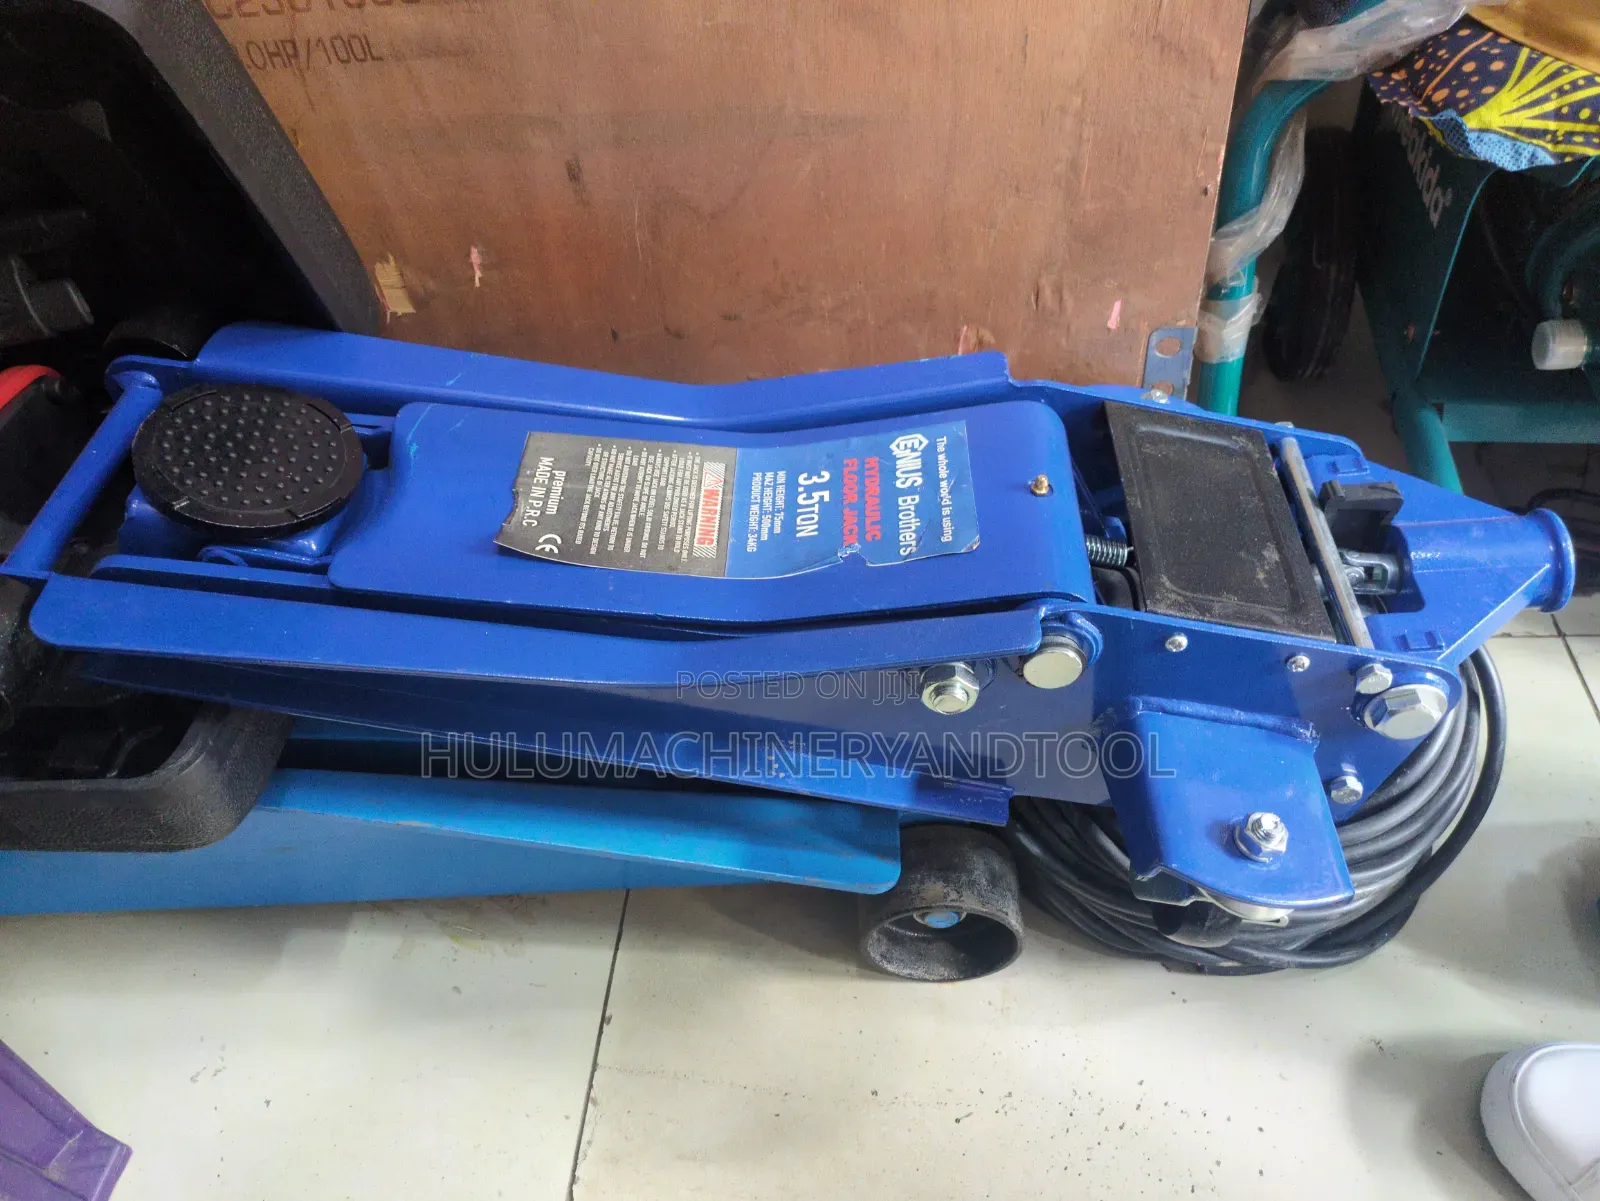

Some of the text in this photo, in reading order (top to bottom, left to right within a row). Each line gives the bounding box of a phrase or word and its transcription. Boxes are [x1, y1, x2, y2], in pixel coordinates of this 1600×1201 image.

[533, 457, 554, 484] MADE
[612, 470, 621, 483] AGENT
[530, 486, 547, 498] IN
[545, 470, 567, 514] premium
[584, 493, 592, 504] JACK
[762, 487, 773, 514] HEIGHT:
[864, 456, 881, 542] HYDRAULIC
[935, 436, 954, 542] The whole world is using
[746, 472, 762, 552] PRODUCT WEIGHT: 34KG
[773, 470, 786, 534] MIN HEIGHT: 75mm
[843, 458, 859, 547] FLOOR JACK
[628, 514, 636, 527] WHEN
[661, 510, 669, 526] SAFETY
[686, 510, 694, 525] LIFTING
[696, 488, 720, 546] WARNING
[760, 514, 770, 540] 500mm
[897, 495, 920, 556] Brothers
[534, 533, 562, 554] CE
[574, 530, 584, 544] RATED
[608, 526, 618, 544] RETURN
[658, 527, 667, 544] STANDS
[682, 526, 691, 549] PURPOSES
